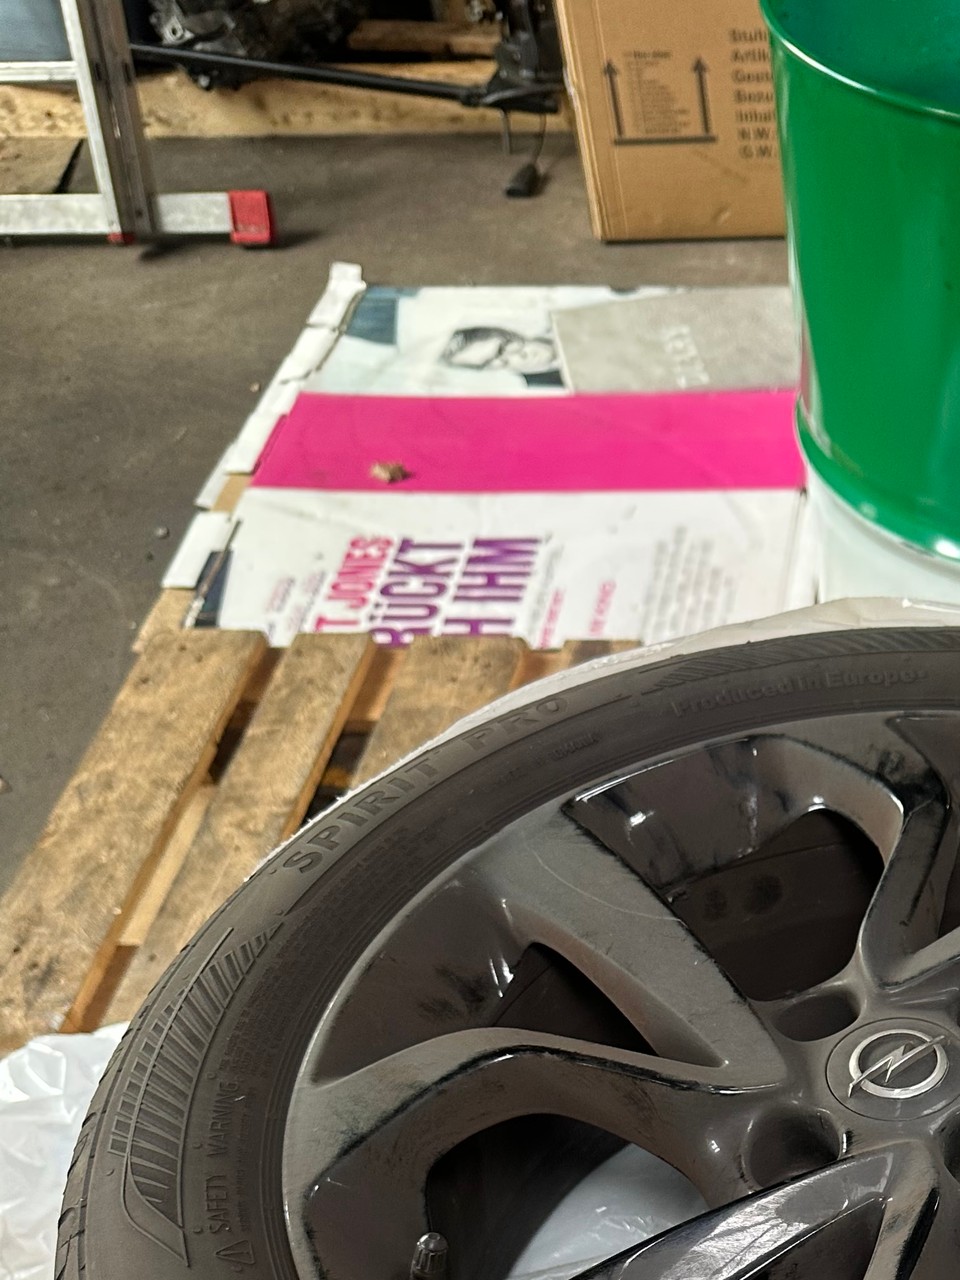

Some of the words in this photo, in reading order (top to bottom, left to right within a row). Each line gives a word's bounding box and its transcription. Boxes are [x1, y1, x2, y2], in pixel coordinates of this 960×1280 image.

[327, 536, 393, 608] JONES
[452, 537, 541, 603] IHM
[284, 759, 439, 874] SPIRIT
[462, 697, 570, 752] PRO
[206, 1080, 239, 1156] WARNING
[206, 1173, 230, 1232] SAFETY
